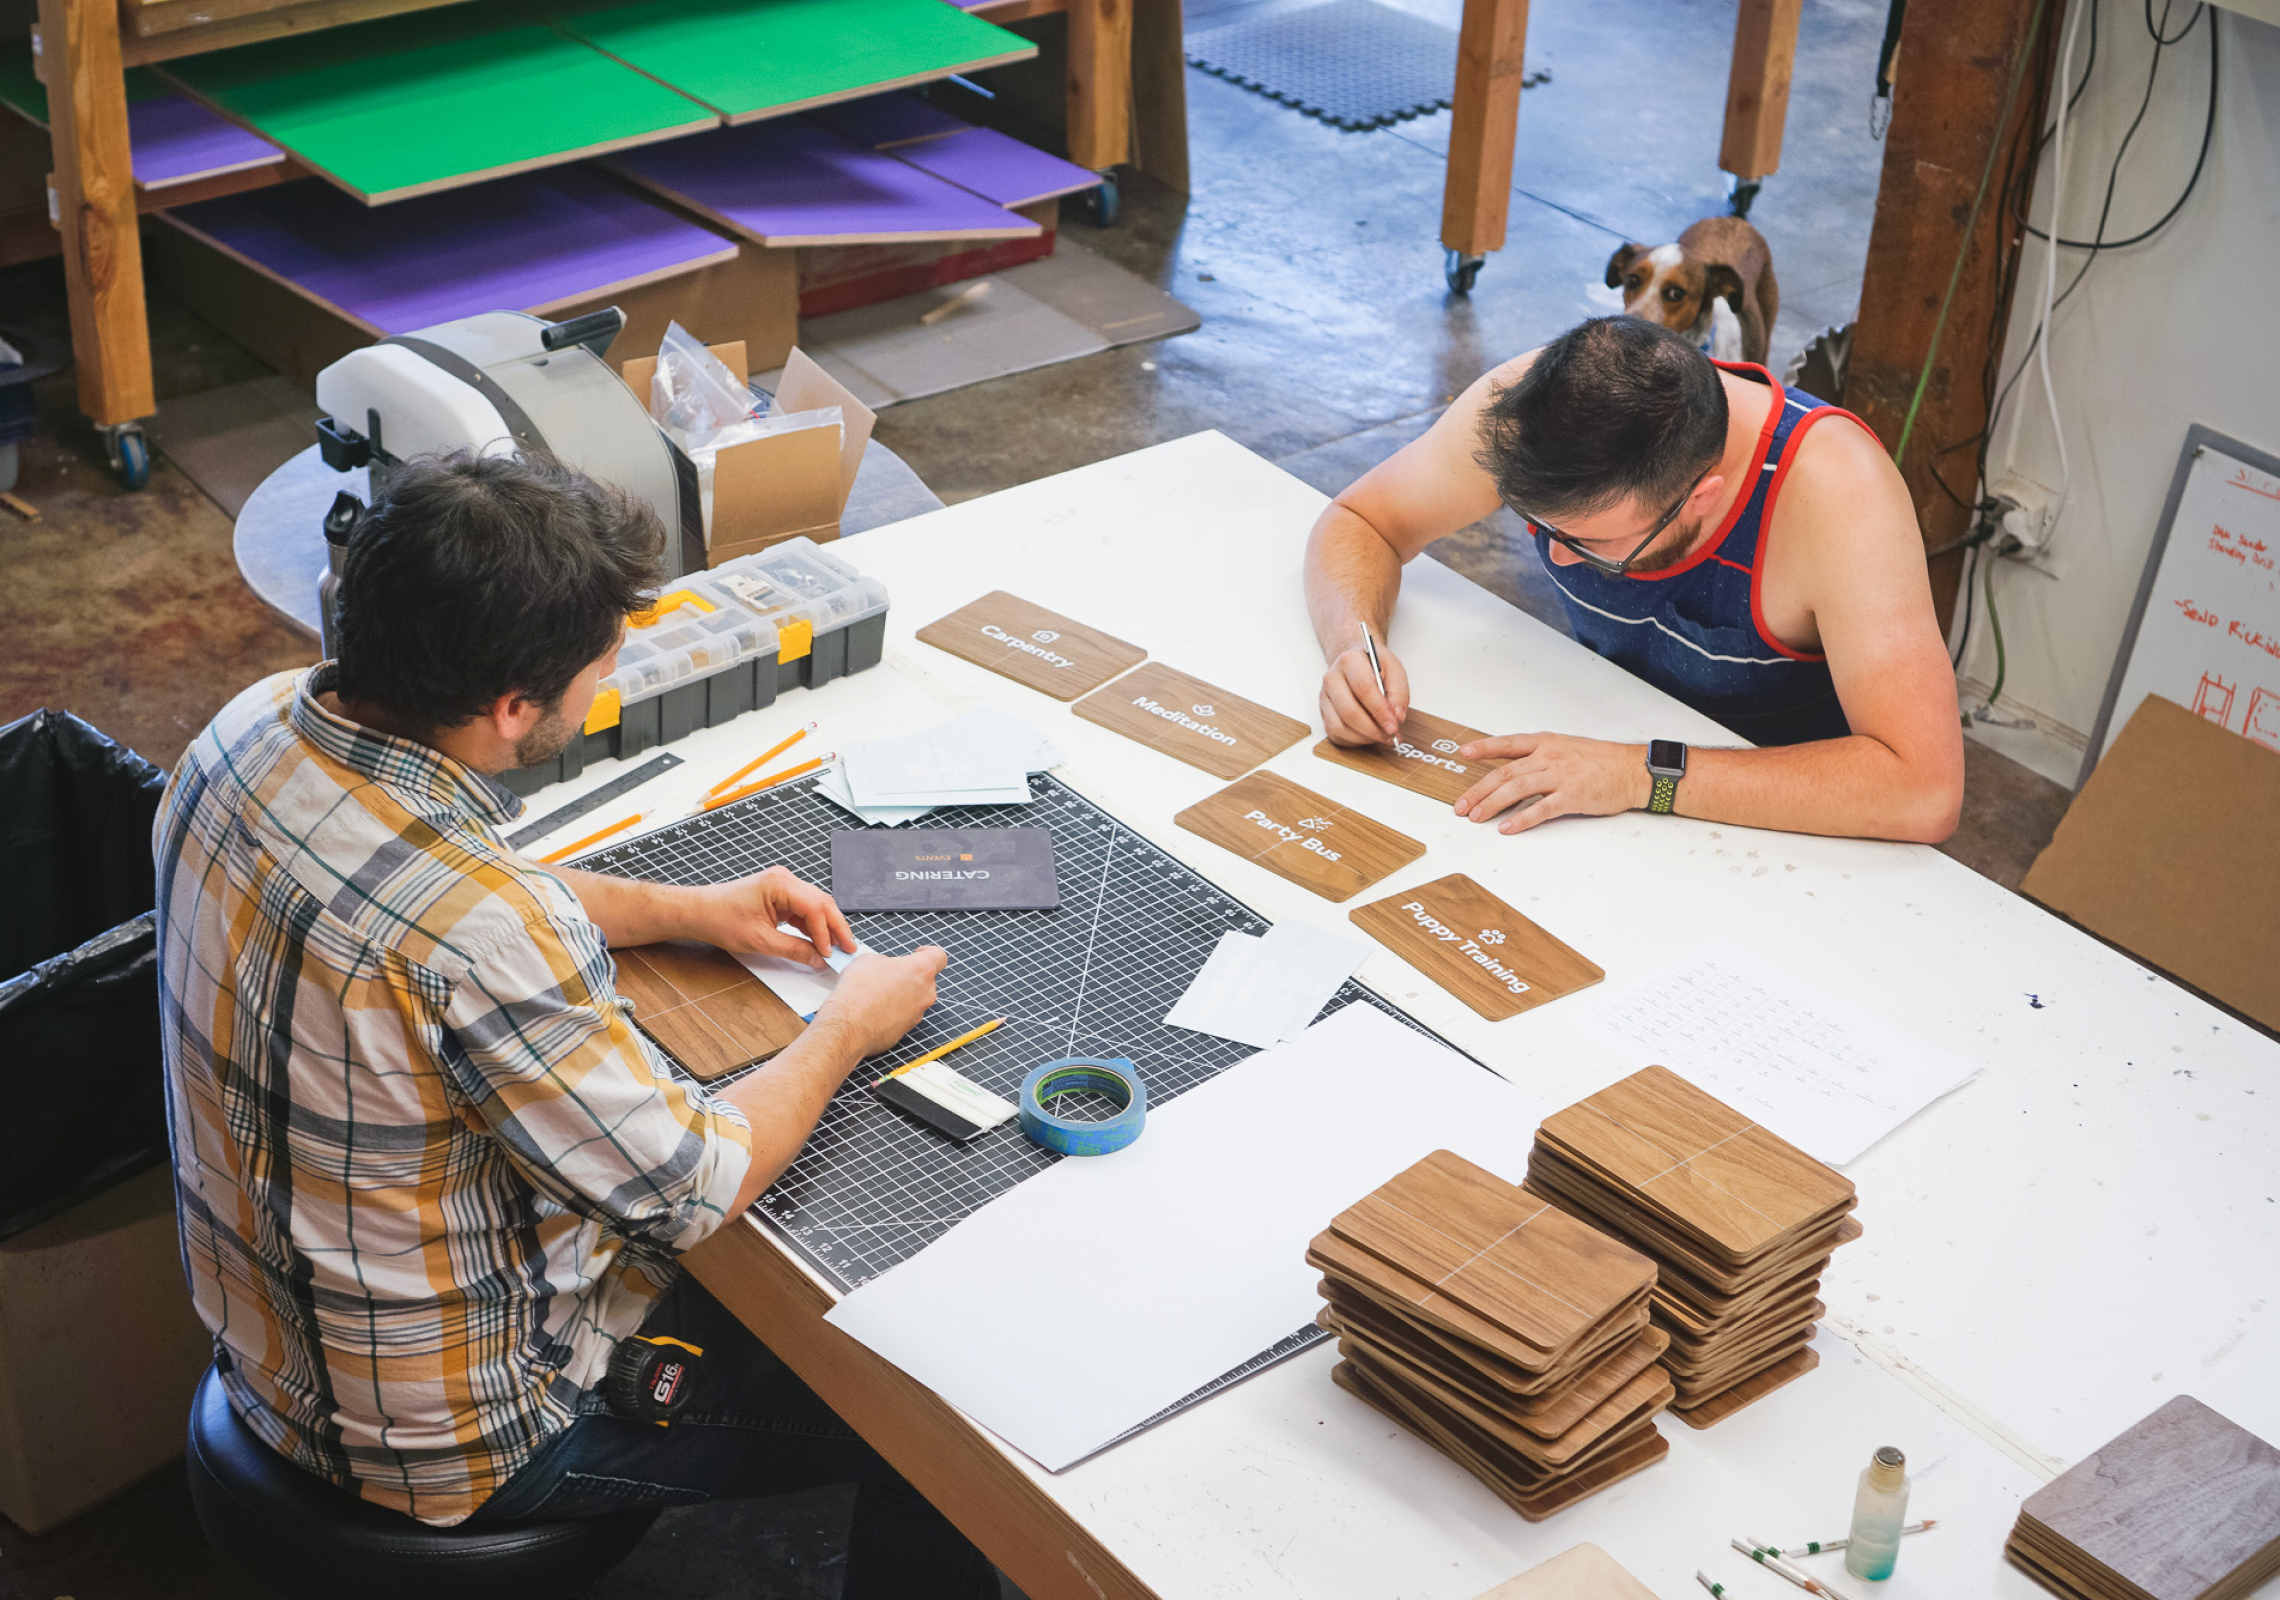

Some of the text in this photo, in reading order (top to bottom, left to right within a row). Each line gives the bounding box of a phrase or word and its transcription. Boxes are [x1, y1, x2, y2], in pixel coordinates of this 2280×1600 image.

[980, 624, 1075, 669] Carpentry
[1131, 696, 1238, 747] Meditation
[1397, 742, 1468, 775] Sports
[698, 818, 712, 828] 12
[1243, 810, 1342, 862] Party Bus
[895, 870, 990, 880] CATERING
[1401, 901, 1531, 994] Puppy Training
[763, 1193, 777, 1204] 15
[781, 1210, 795, 1220] 14
[799, 1225, 814, 1236] 13
[819, 1242, 833, 1253] 12
[838, 1259, 852, 1269] 11
[653, 1364, 678, 1402] G16
